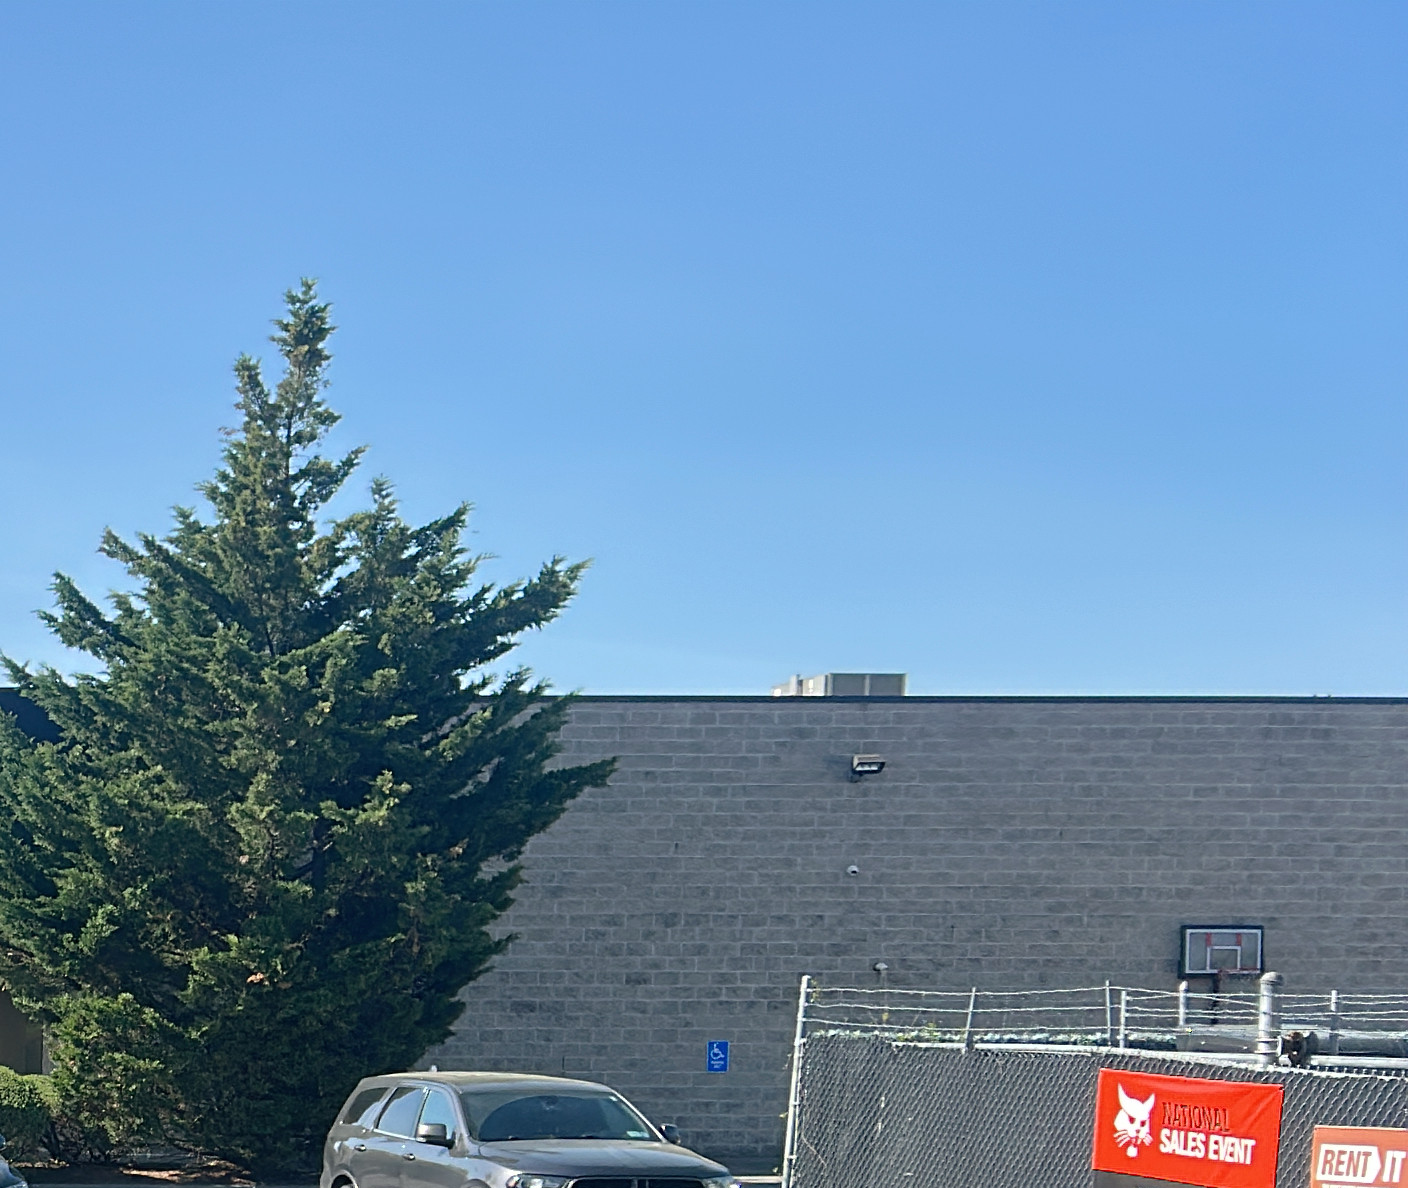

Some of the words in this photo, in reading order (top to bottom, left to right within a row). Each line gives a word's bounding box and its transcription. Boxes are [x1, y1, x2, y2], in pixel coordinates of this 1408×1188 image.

[1161, 1101, 1231, 1132] NATIONAL
[1159, 1127, 1205, 1159] SALES
[1207, 1134, 1256, 1165] EVENT
[1321, 1149, 1372, 1178] RENT
[1382, 1150, 1406, 1182] IT
